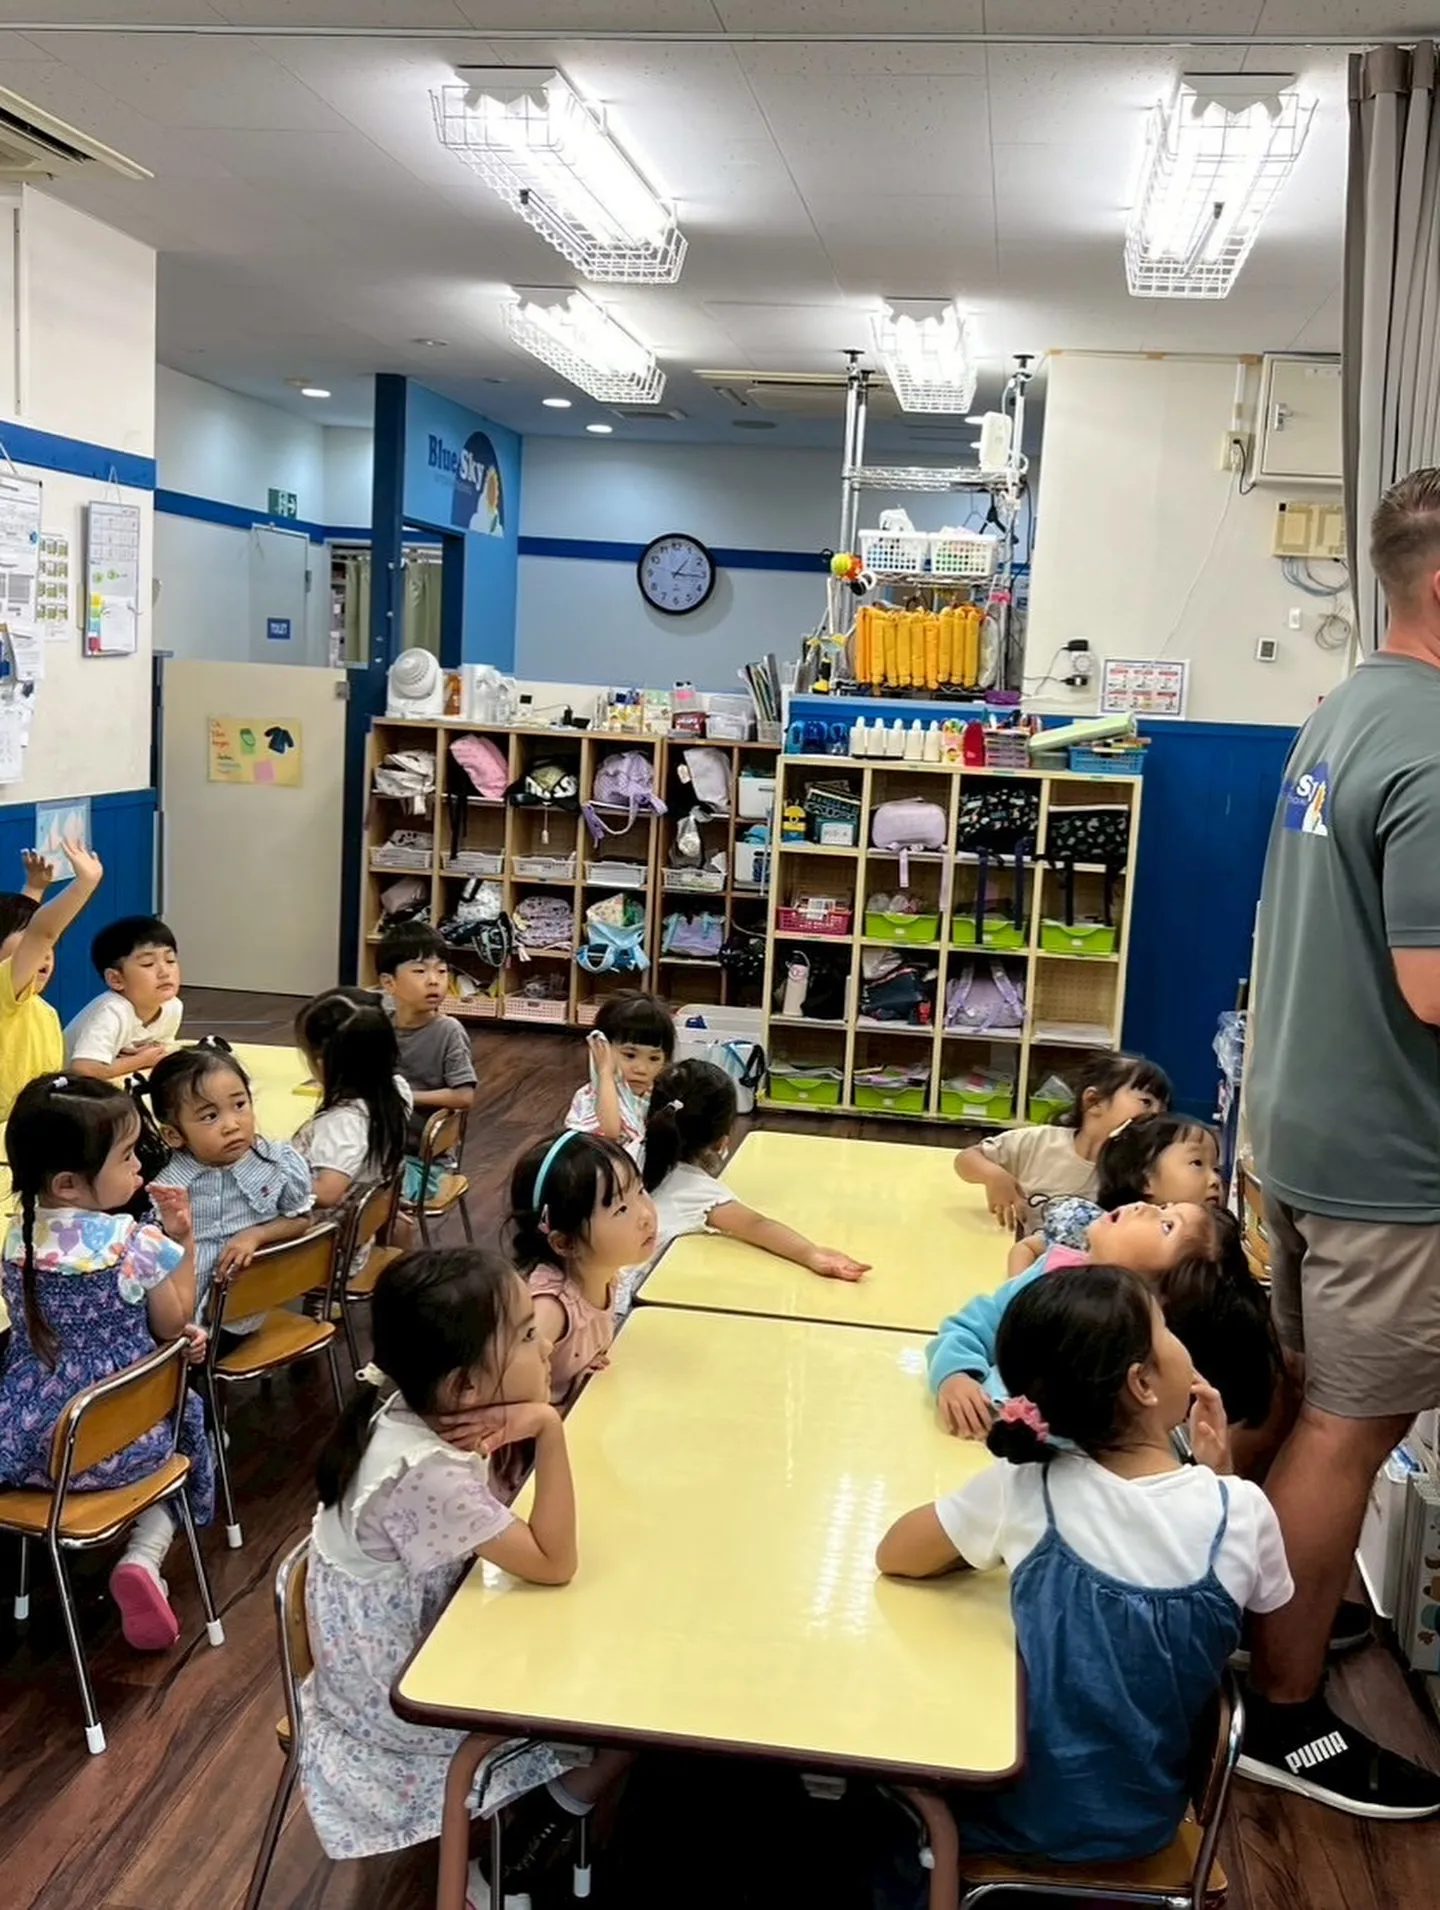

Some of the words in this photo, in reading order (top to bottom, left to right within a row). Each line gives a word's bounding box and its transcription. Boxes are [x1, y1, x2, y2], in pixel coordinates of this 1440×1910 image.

[428, 434, 457, 473] Blue
[459, 449, 485, 492] Sky
[1284, 1730, 1349, 1775] PUMA
